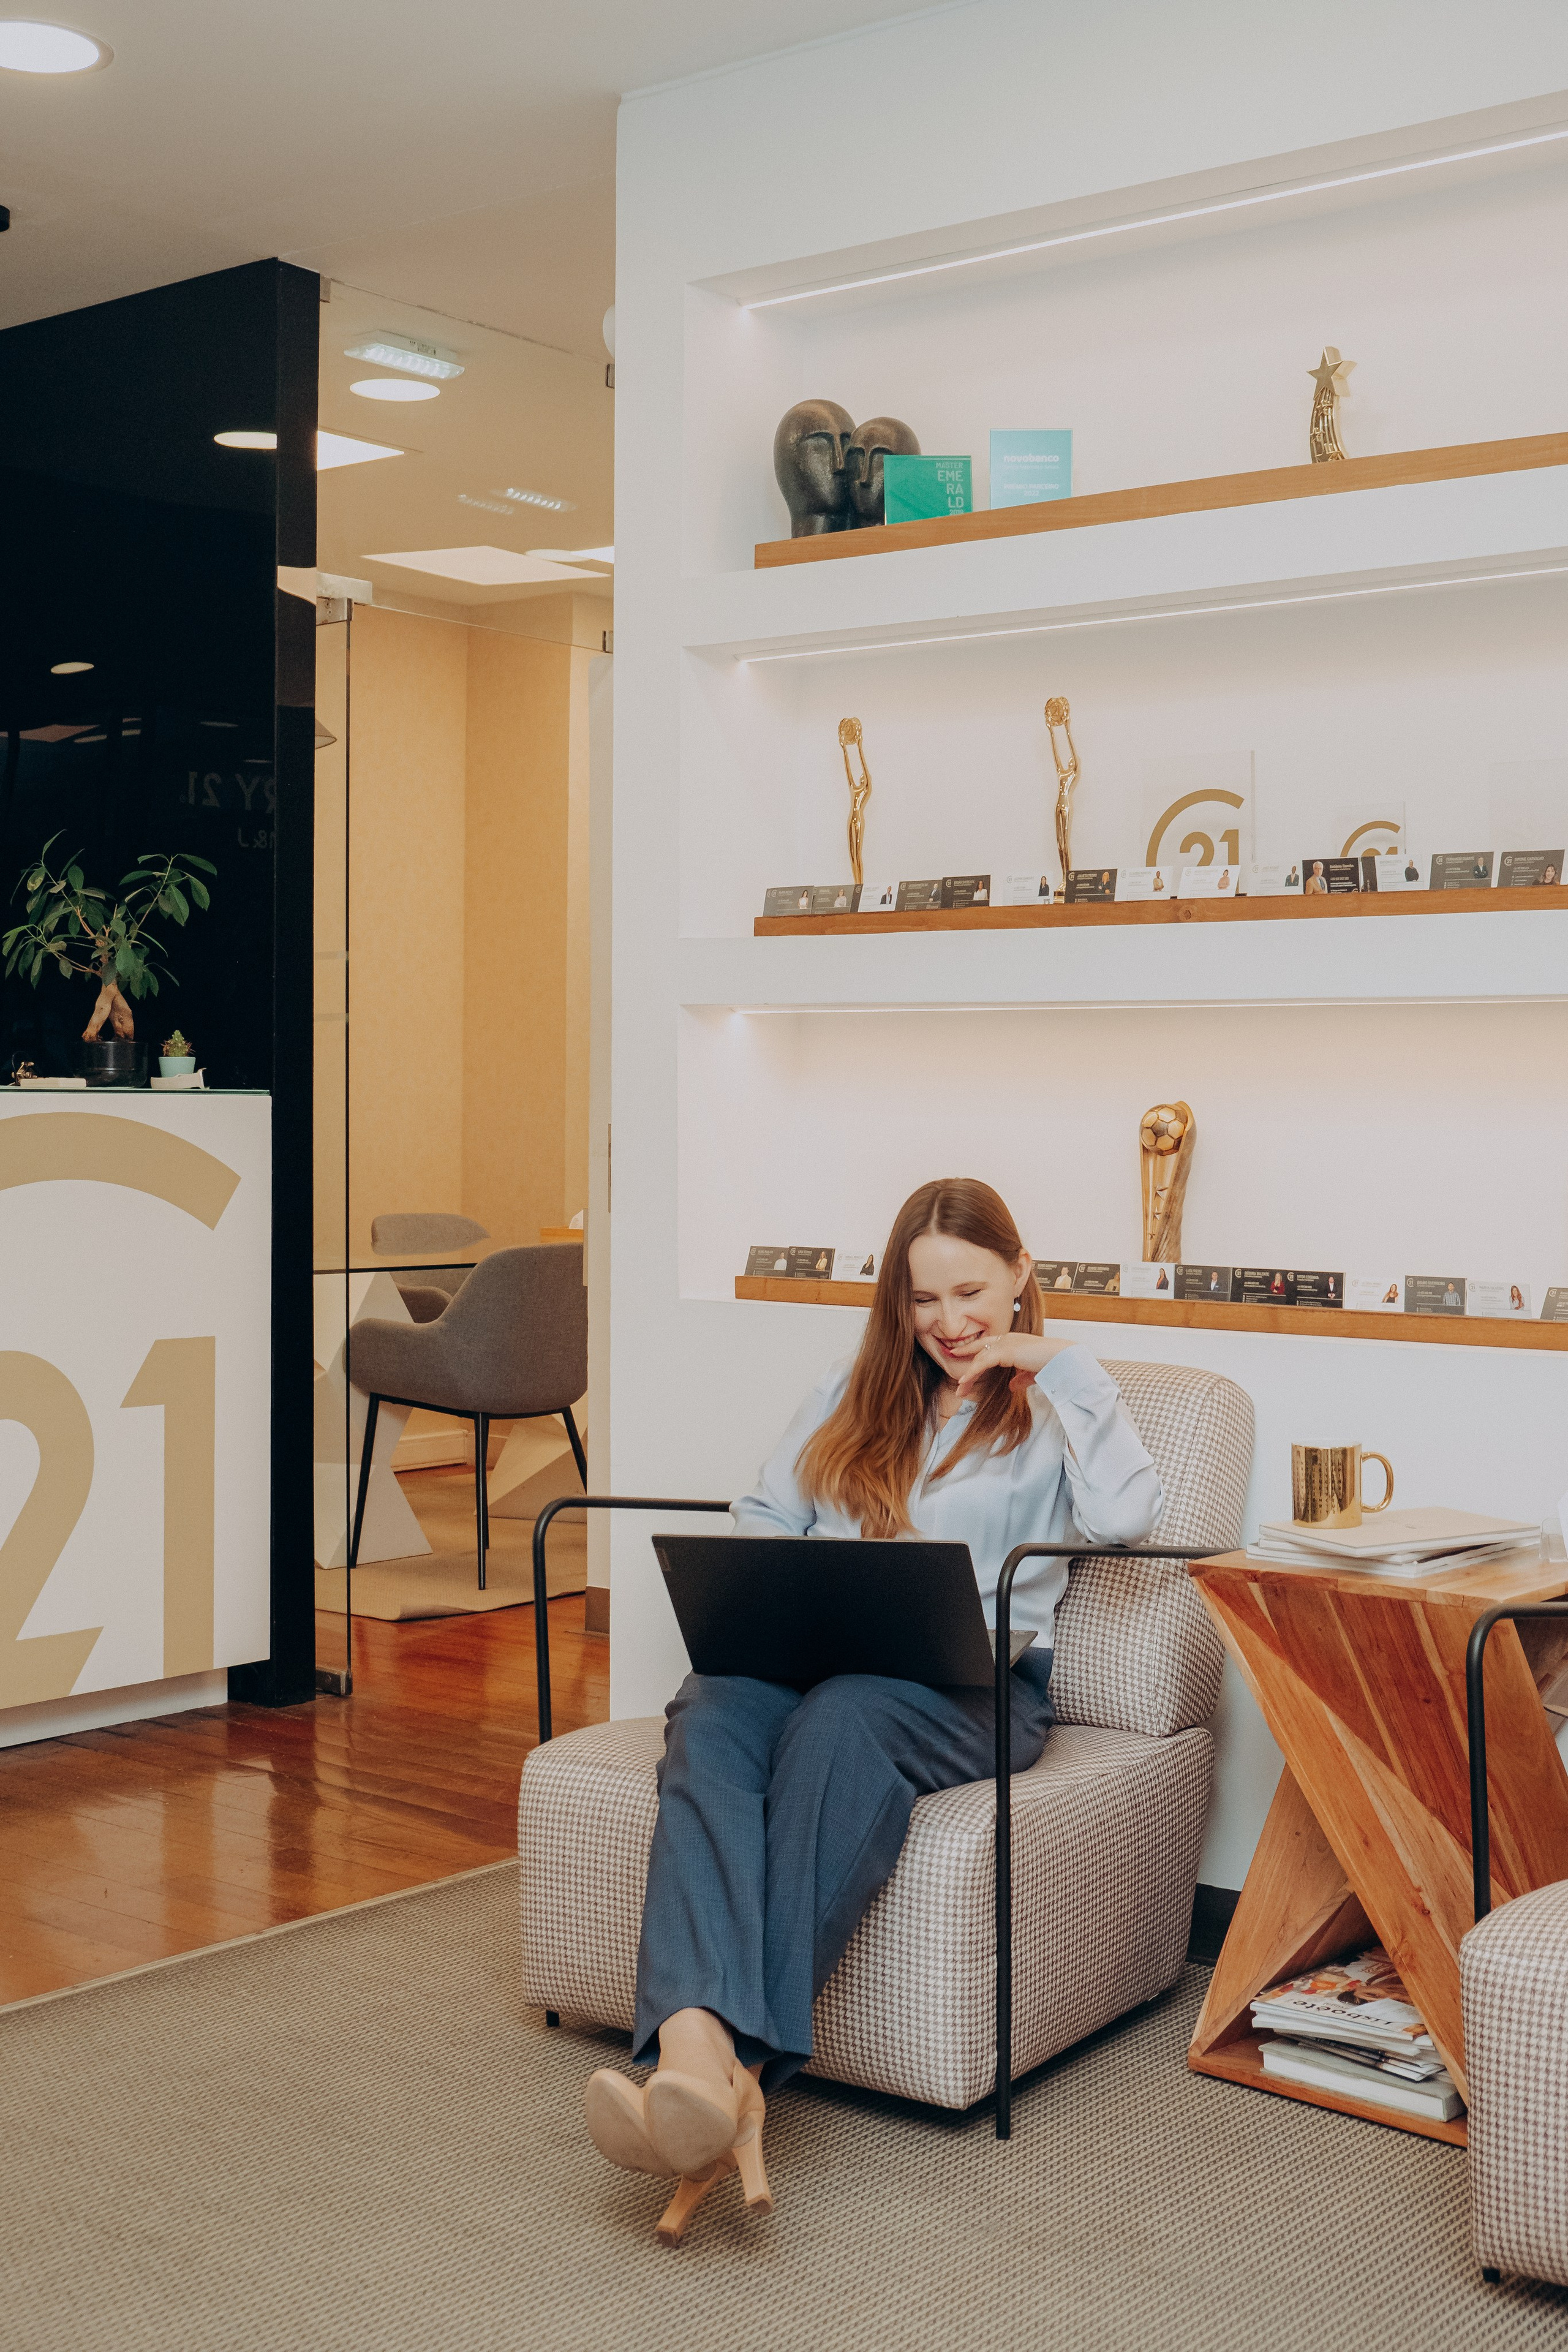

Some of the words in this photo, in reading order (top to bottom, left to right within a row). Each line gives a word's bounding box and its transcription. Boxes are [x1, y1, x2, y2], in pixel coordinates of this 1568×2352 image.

[1003, 453, 1060, 462] novobanco
[937, 470, 963, 481] EME
[946, 483, 963, 494] RA
[948, 496, 964, 508] LD
